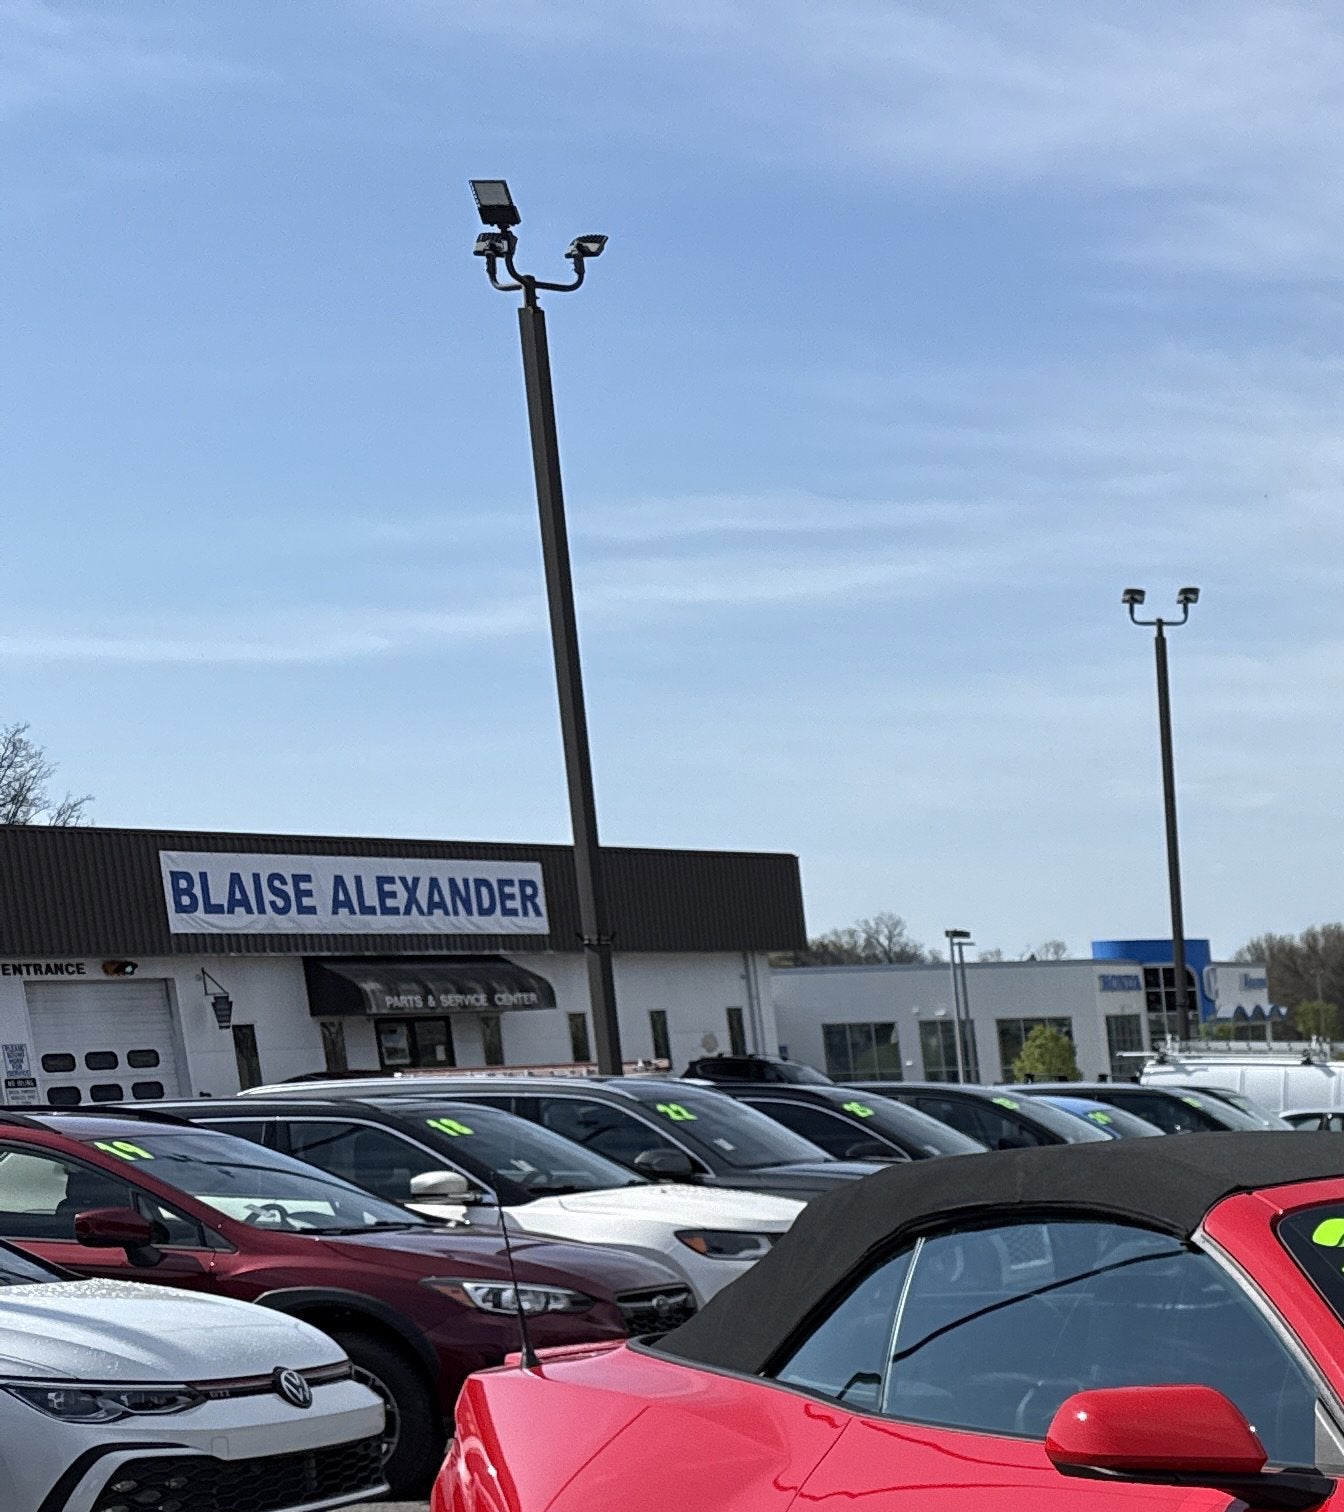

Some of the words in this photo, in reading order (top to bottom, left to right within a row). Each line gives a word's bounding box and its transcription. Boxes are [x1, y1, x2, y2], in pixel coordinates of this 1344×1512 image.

[170, 870, 318, 915] BLAISE
[331, 875, 543, 917] ALEXANDER
[1, 962, 87, 976] ENTRANCE
[385, 995, 423, 1008] PARTS
[428, 995, 436, 1007] &
[440, 992, 488, 1007] SERVICE
[494, 991, 538, 1006] CENTER
[426, 1118, 474, 1137] 18
[93, 1140, 155, 1161] 19
